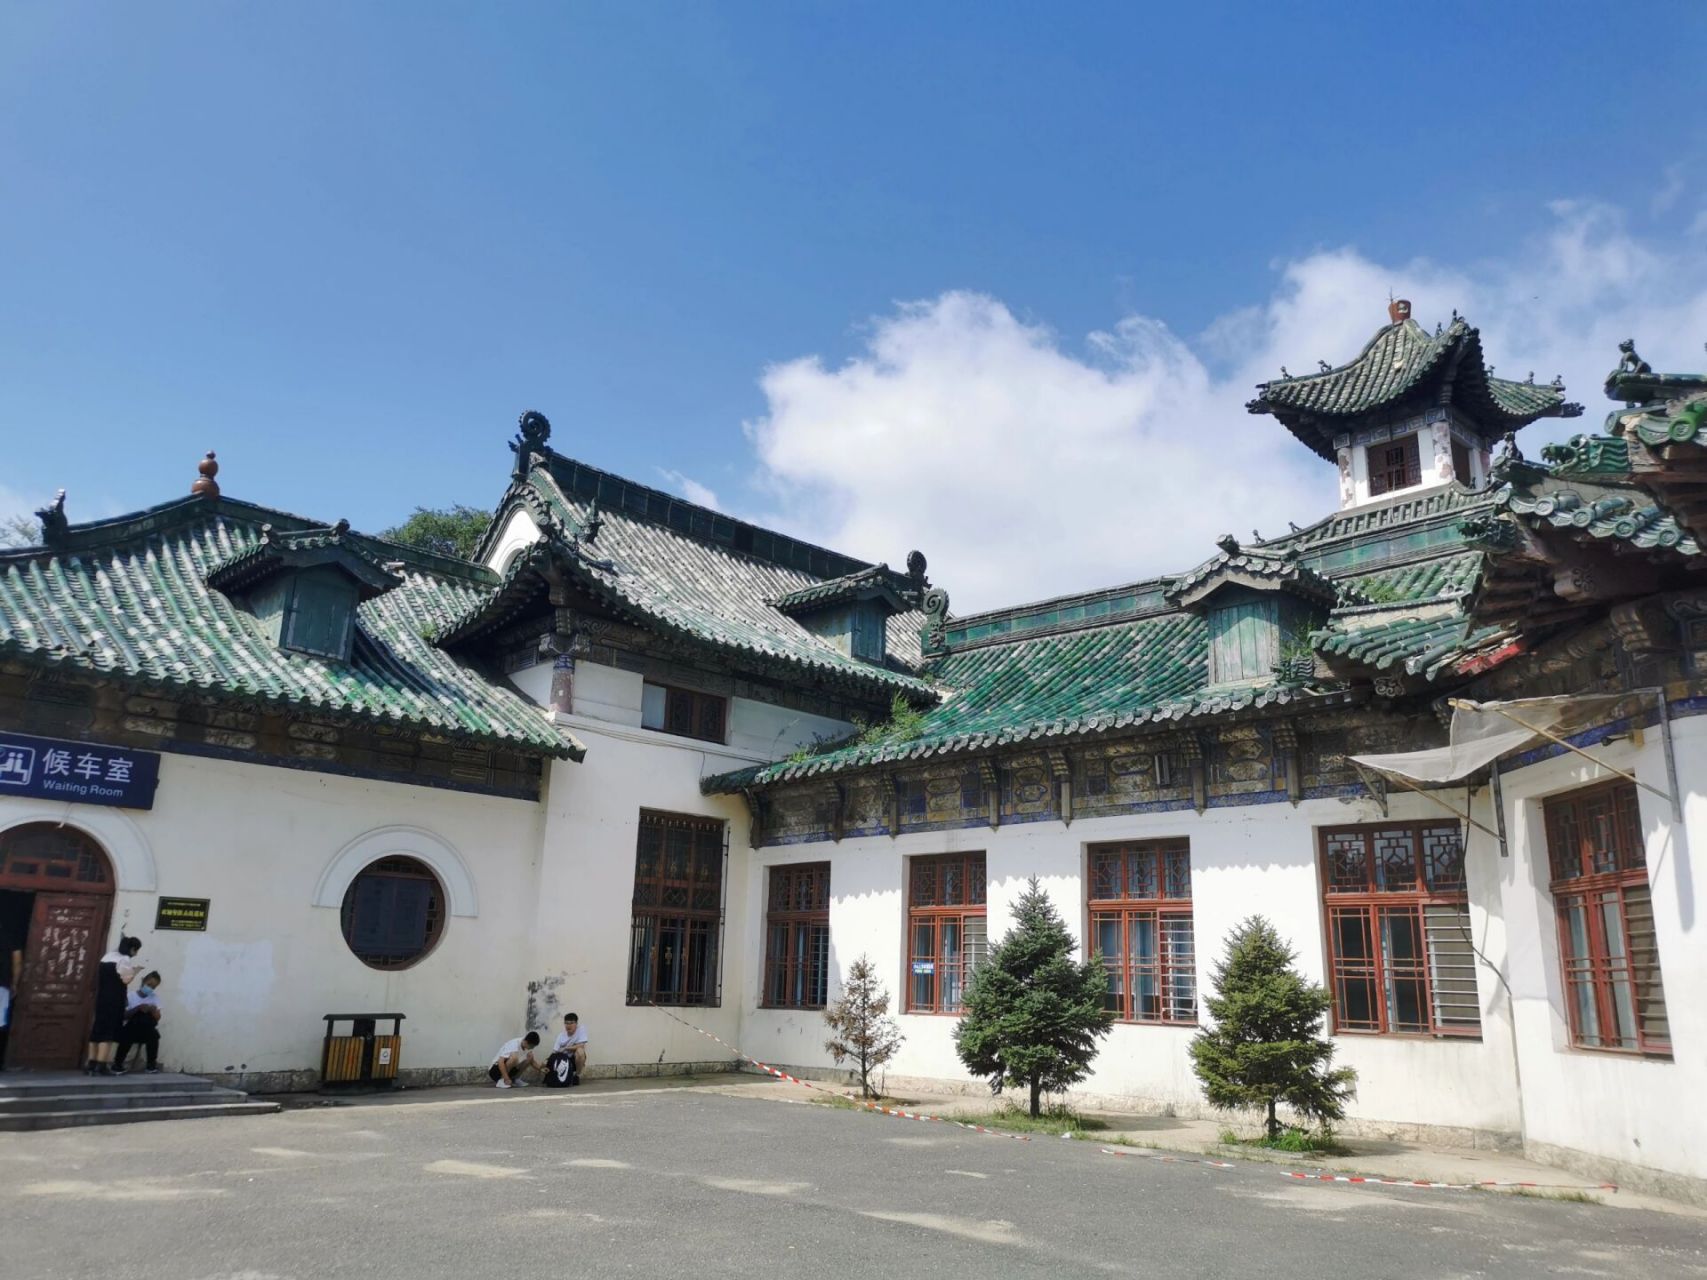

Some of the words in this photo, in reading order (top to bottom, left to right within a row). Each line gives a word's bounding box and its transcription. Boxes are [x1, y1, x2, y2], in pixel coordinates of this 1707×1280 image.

[42, 748, 133, 783] 候车室
[43, 780, 88, 795] Waiting
[89, 785, 123, 797] Room
